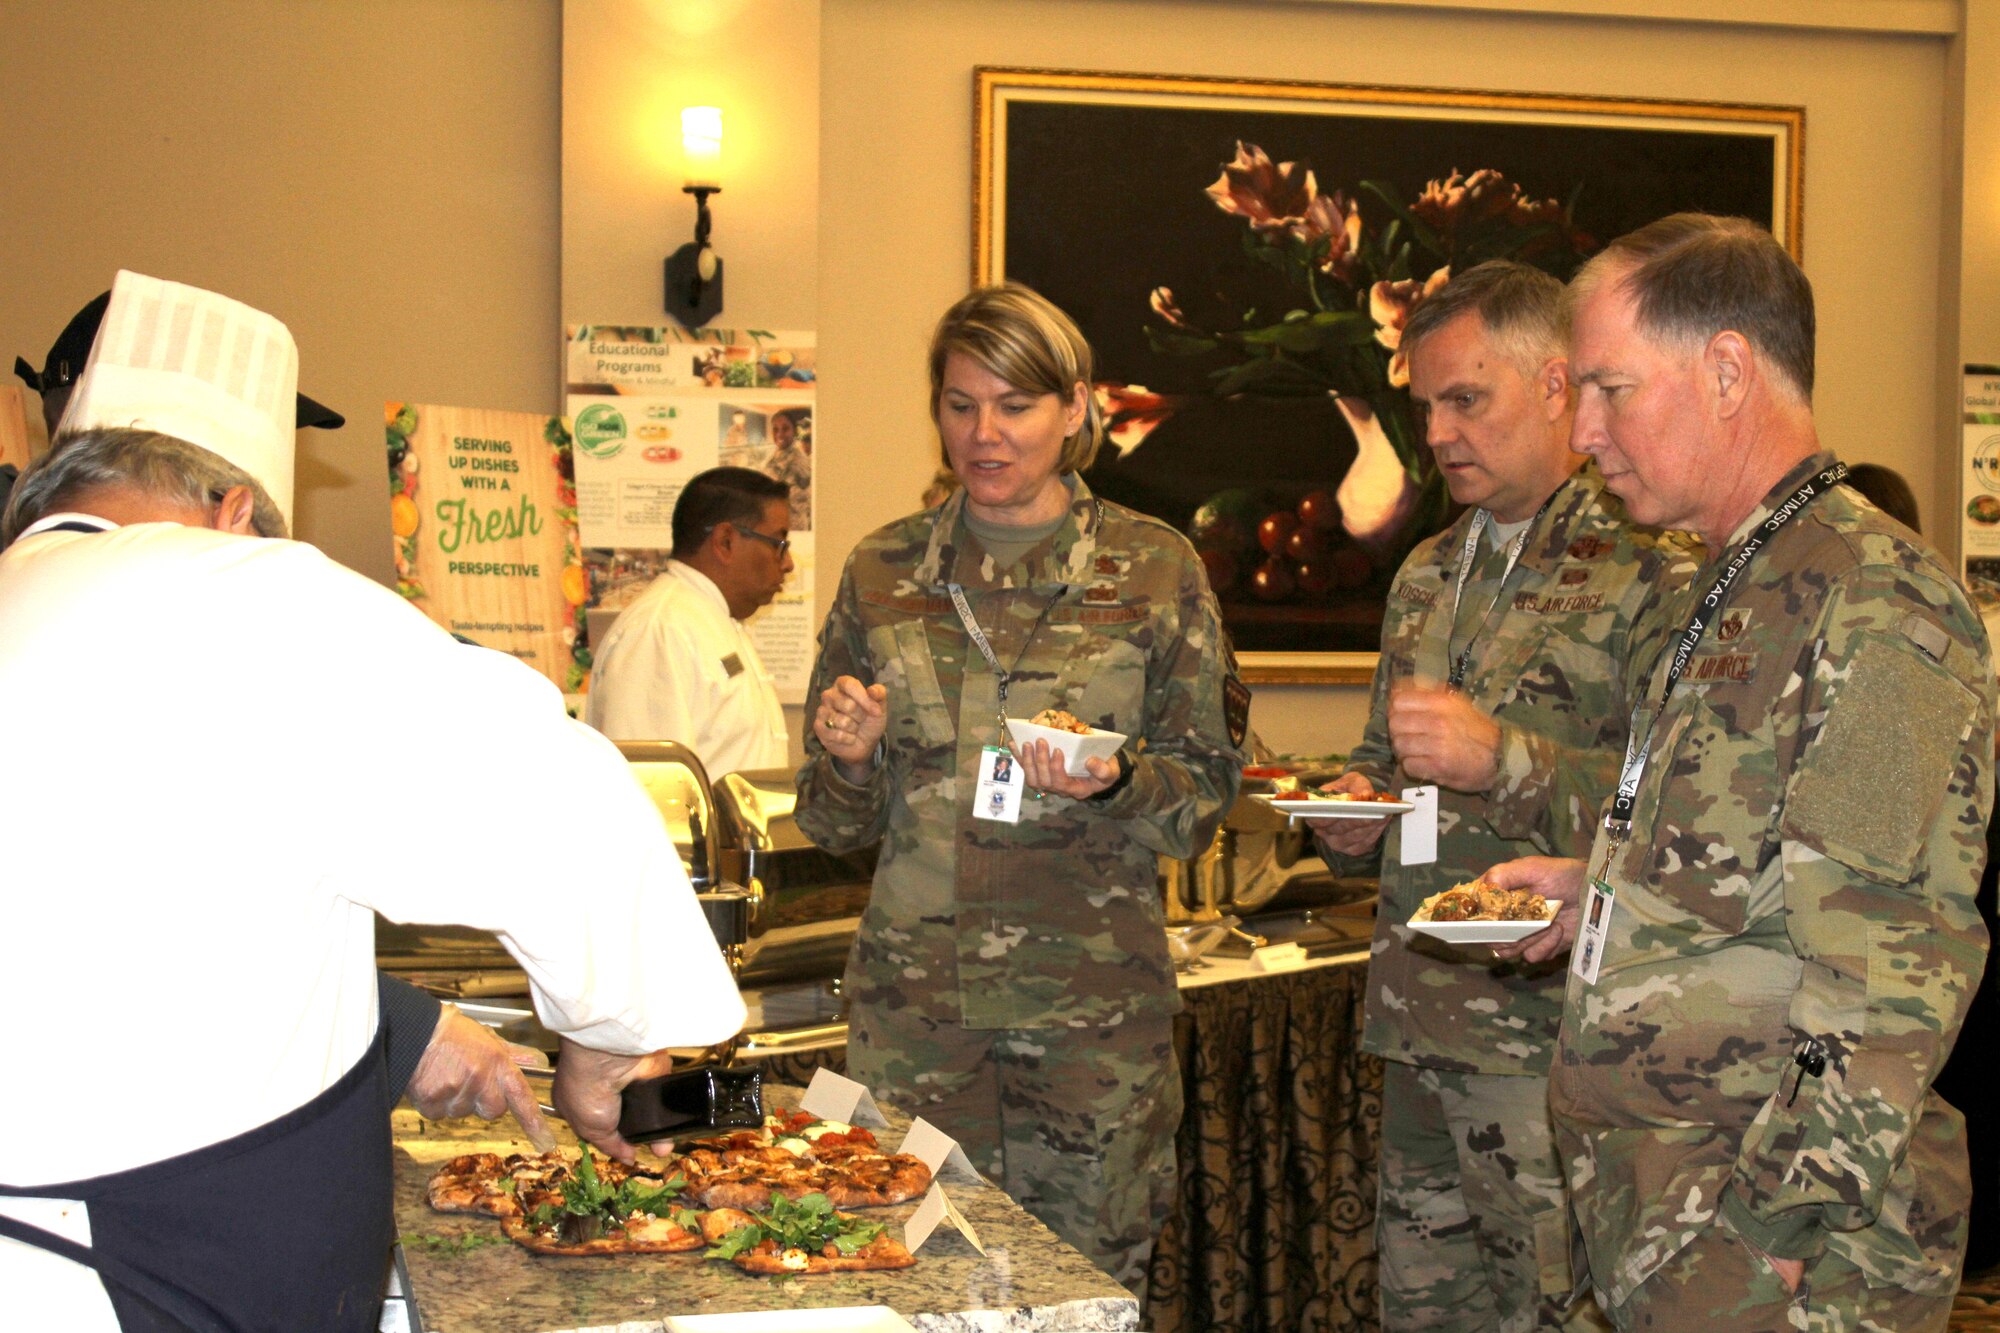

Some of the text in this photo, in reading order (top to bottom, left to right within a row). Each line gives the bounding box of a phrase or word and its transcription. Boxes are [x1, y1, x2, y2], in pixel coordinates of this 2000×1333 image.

[589, 342, 670, 356] Educational
[597, 360, 662, 374] Programs
[454, 437, 512, 453] SERVING
[449, 456, 519, 473] UP DISHES
[460, 475, 511, 491] WITH A
[1765, 484, 1815, 531] AFIMSC
[436, 494, 544, 554] Fresh
[449, 561, 540, 577] PERSPECTIVE
[1705, 538, 1762, 608] I-WEPTAC
[450, 620, 545, 633] Taste-tempting recipes
[1670, 617, 1703, 679] AFIMSC
